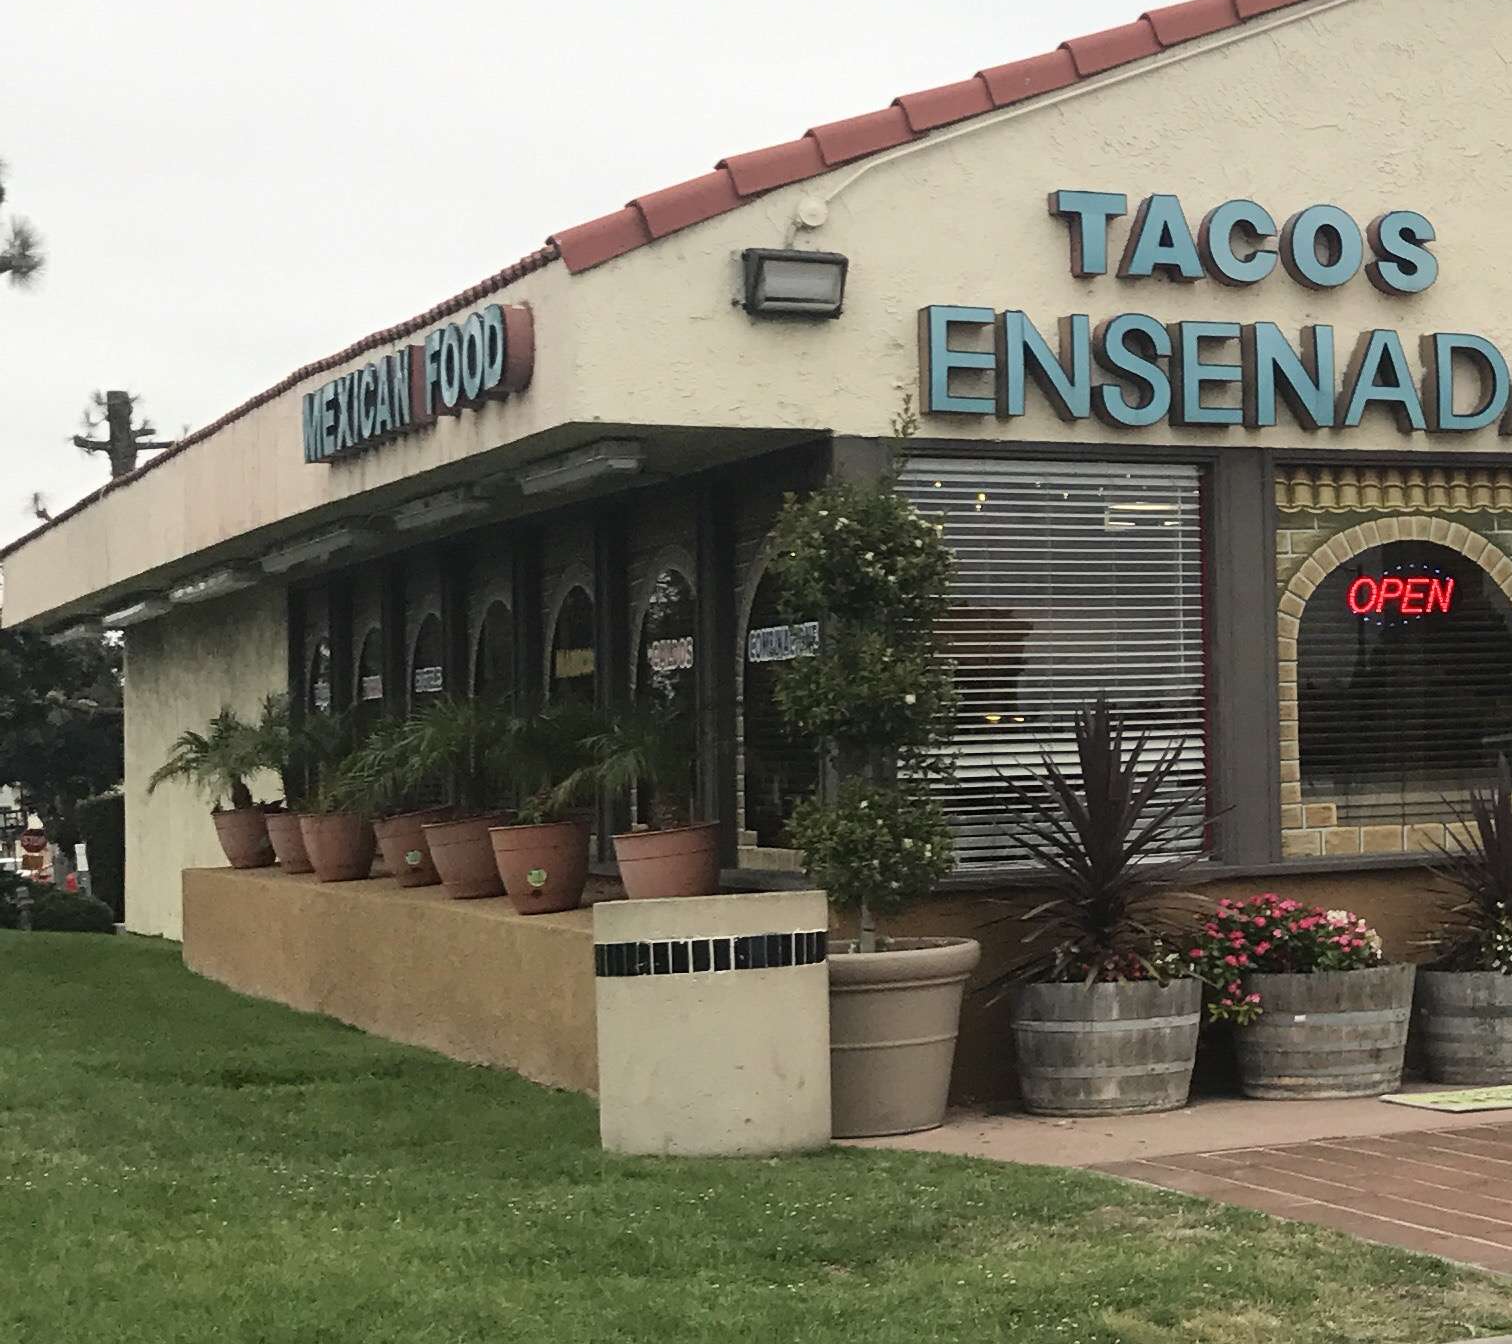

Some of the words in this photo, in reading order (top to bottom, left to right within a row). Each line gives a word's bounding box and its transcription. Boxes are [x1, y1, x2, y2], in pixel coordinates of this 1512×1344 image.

[1048, 189, 1439, 294] TACOS
[302, 344, 411, 463] MEXICAN
[425, 304, 506, 416] FOOD
[1348, 577, 1455, 613] OPEN
